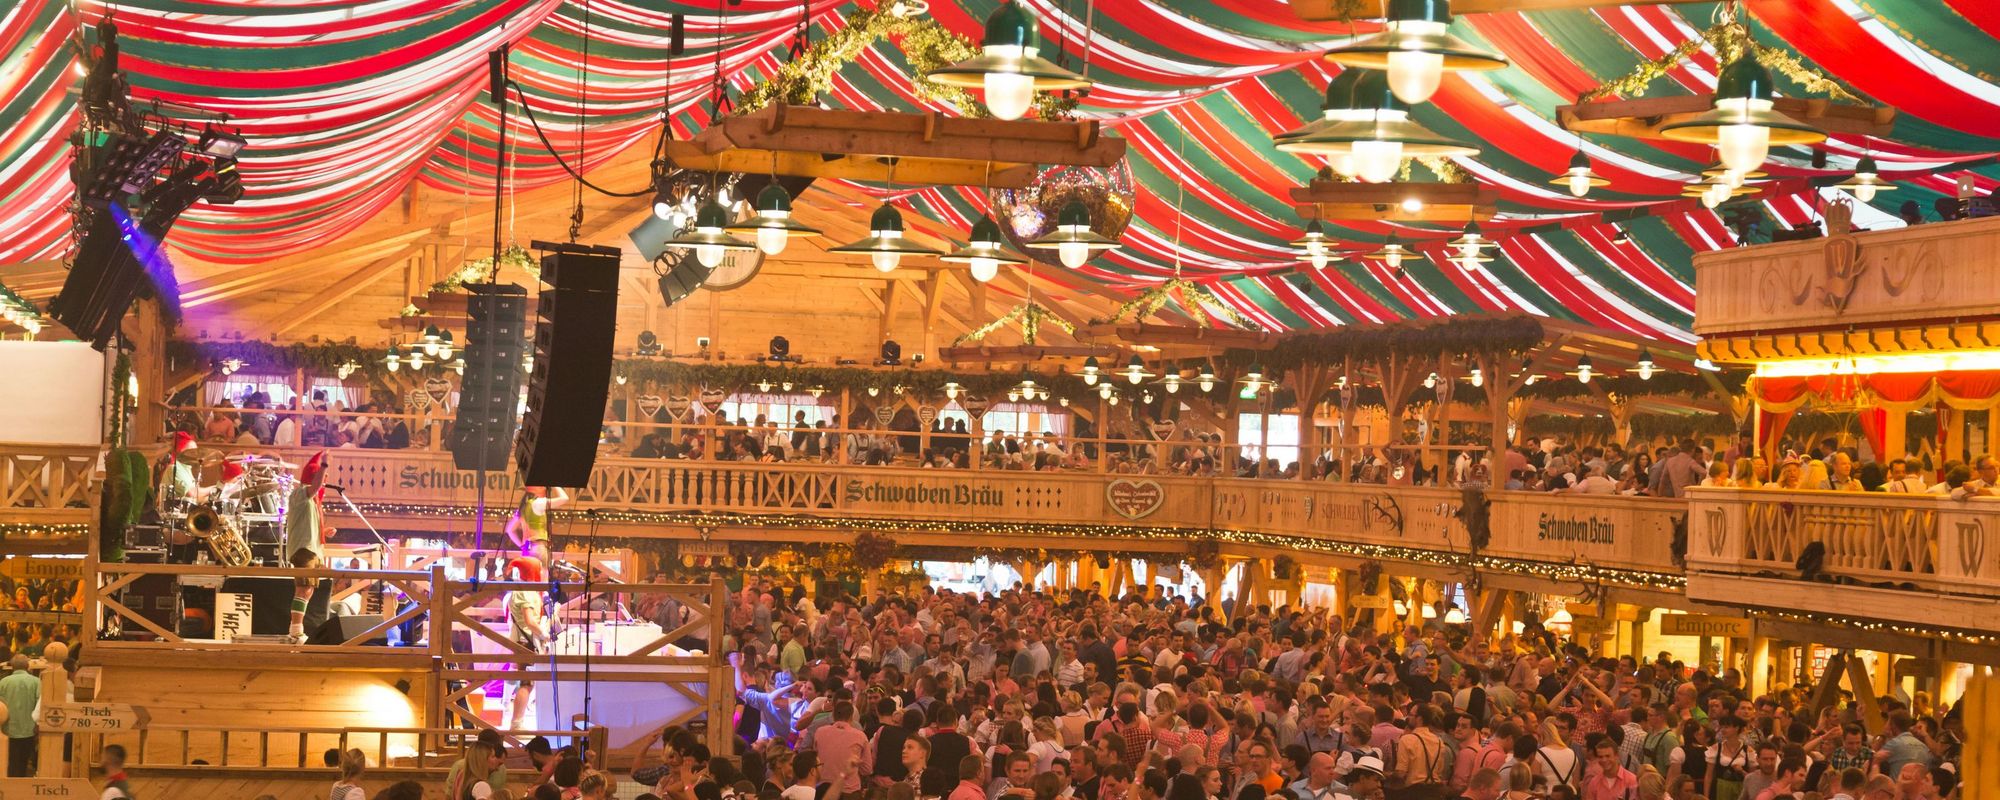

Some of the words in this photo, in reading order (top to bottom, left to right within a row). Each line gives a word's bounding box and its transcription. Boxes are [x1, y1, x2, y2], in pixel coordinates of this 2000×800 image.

[845, 479, 950, 504] Schwaben
[954, 484, 1004, 506] Bräu
[1538, 512, 1588, 543] Schwaben
[1589, 513, 1615, 545] Bräu
[26, 560, 84, 578] Empor
[234, 594, 252, 617] HEY
[1675, 617, 1742, 637] Empore
[81, 706, 112, 717] Tisch
[70, 718, 91, 728] 780
[101, 718, 121, 728] 791
[32, 783, 69, 796] Tisch
